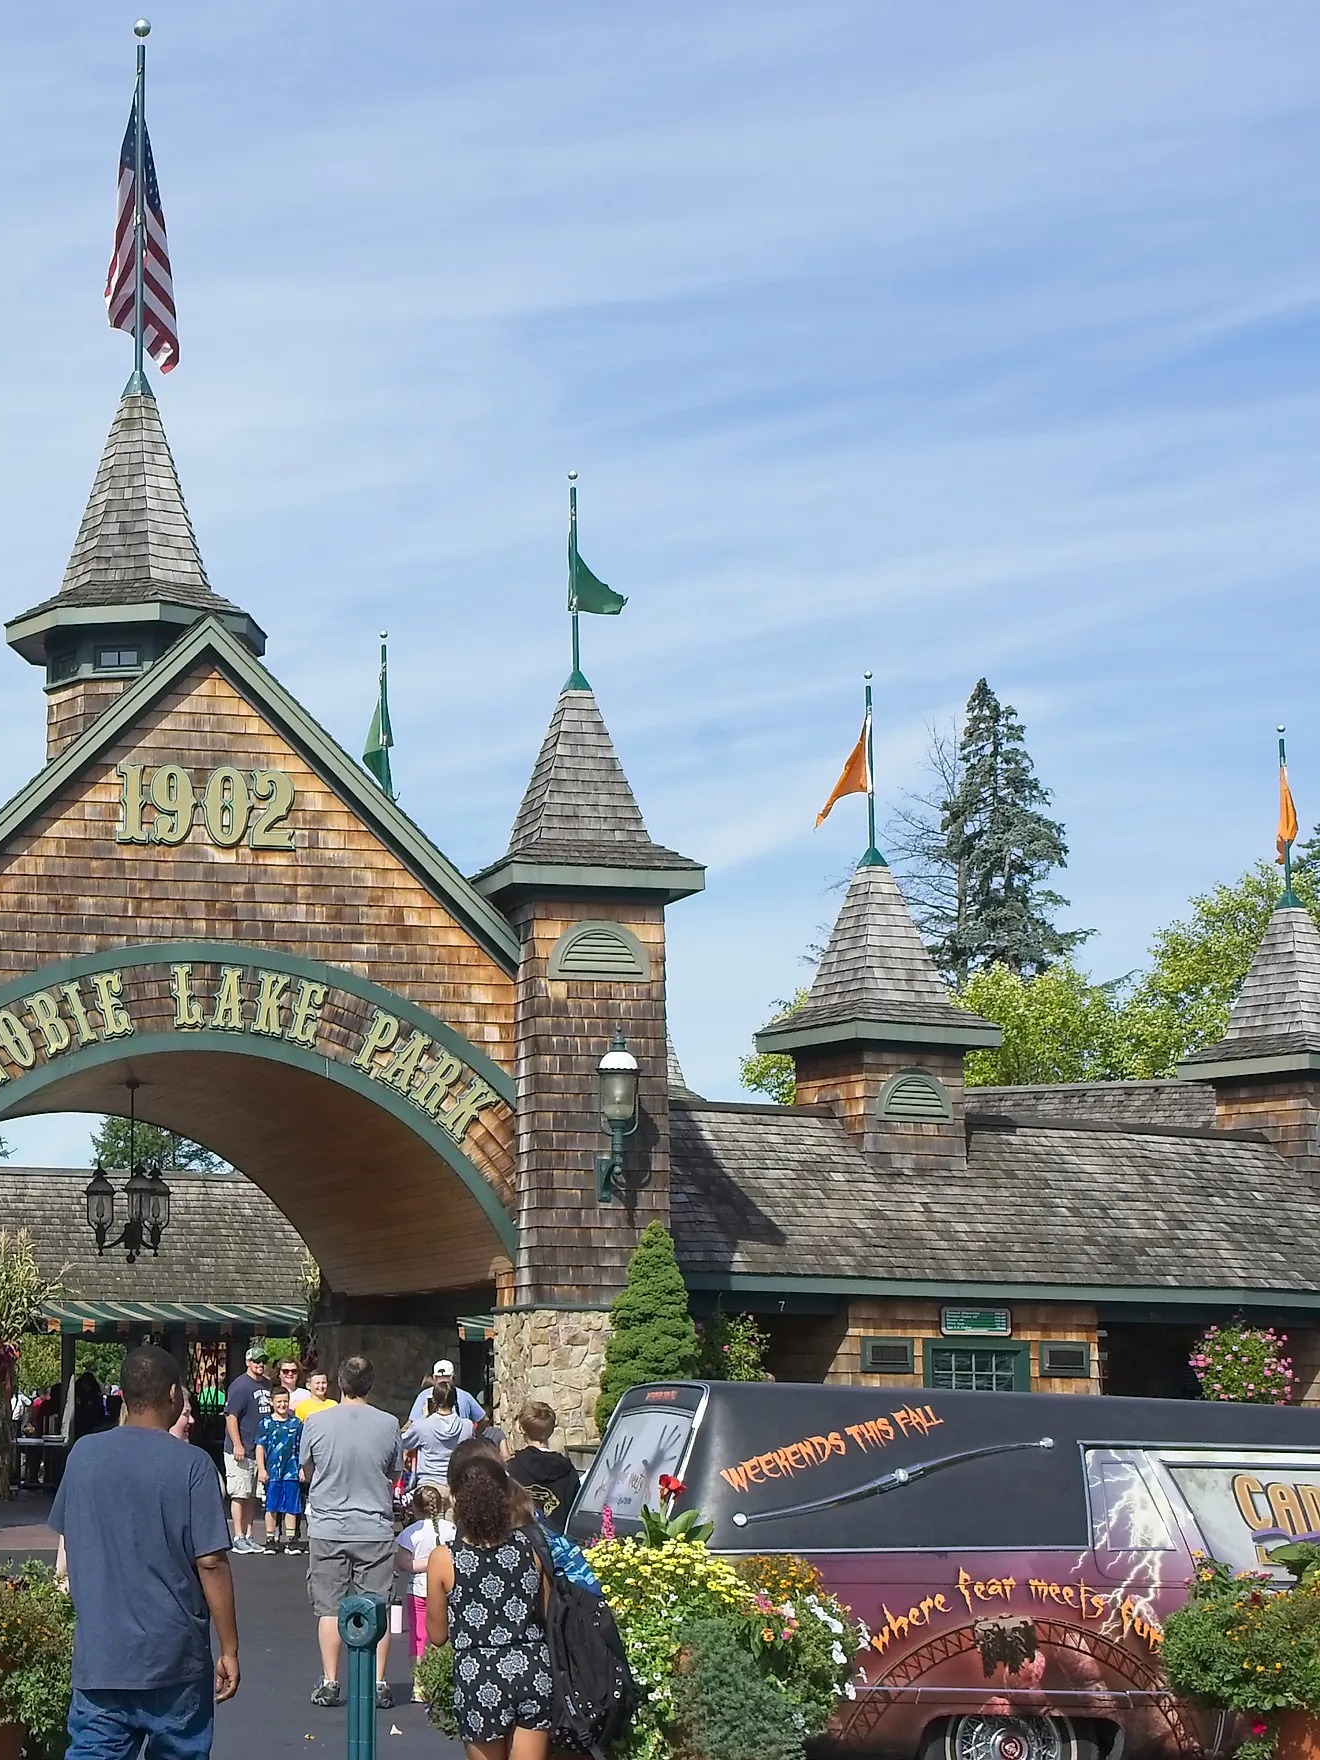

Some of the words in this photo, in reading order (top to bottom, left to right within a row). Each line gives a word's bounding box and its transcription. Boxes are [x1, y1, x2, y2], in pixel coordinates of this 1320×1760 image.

[116, 764, 296, 850] 1902
[171, 964, 328, 1048] LAKE
[351, 1008, 501, 1143] PARK
[778, 1300, 786, 1312] 7
[719, 1431, 847, 1493] WEEKENDS
[844, 1417, 896, 1454] THIS
[890, 1403, 945, 1438] FALL
[870, 1592, 954, 1656] where
[955, 1566, 1016, 1614] fear
[1028, 1578, 1107, 1620] meets
